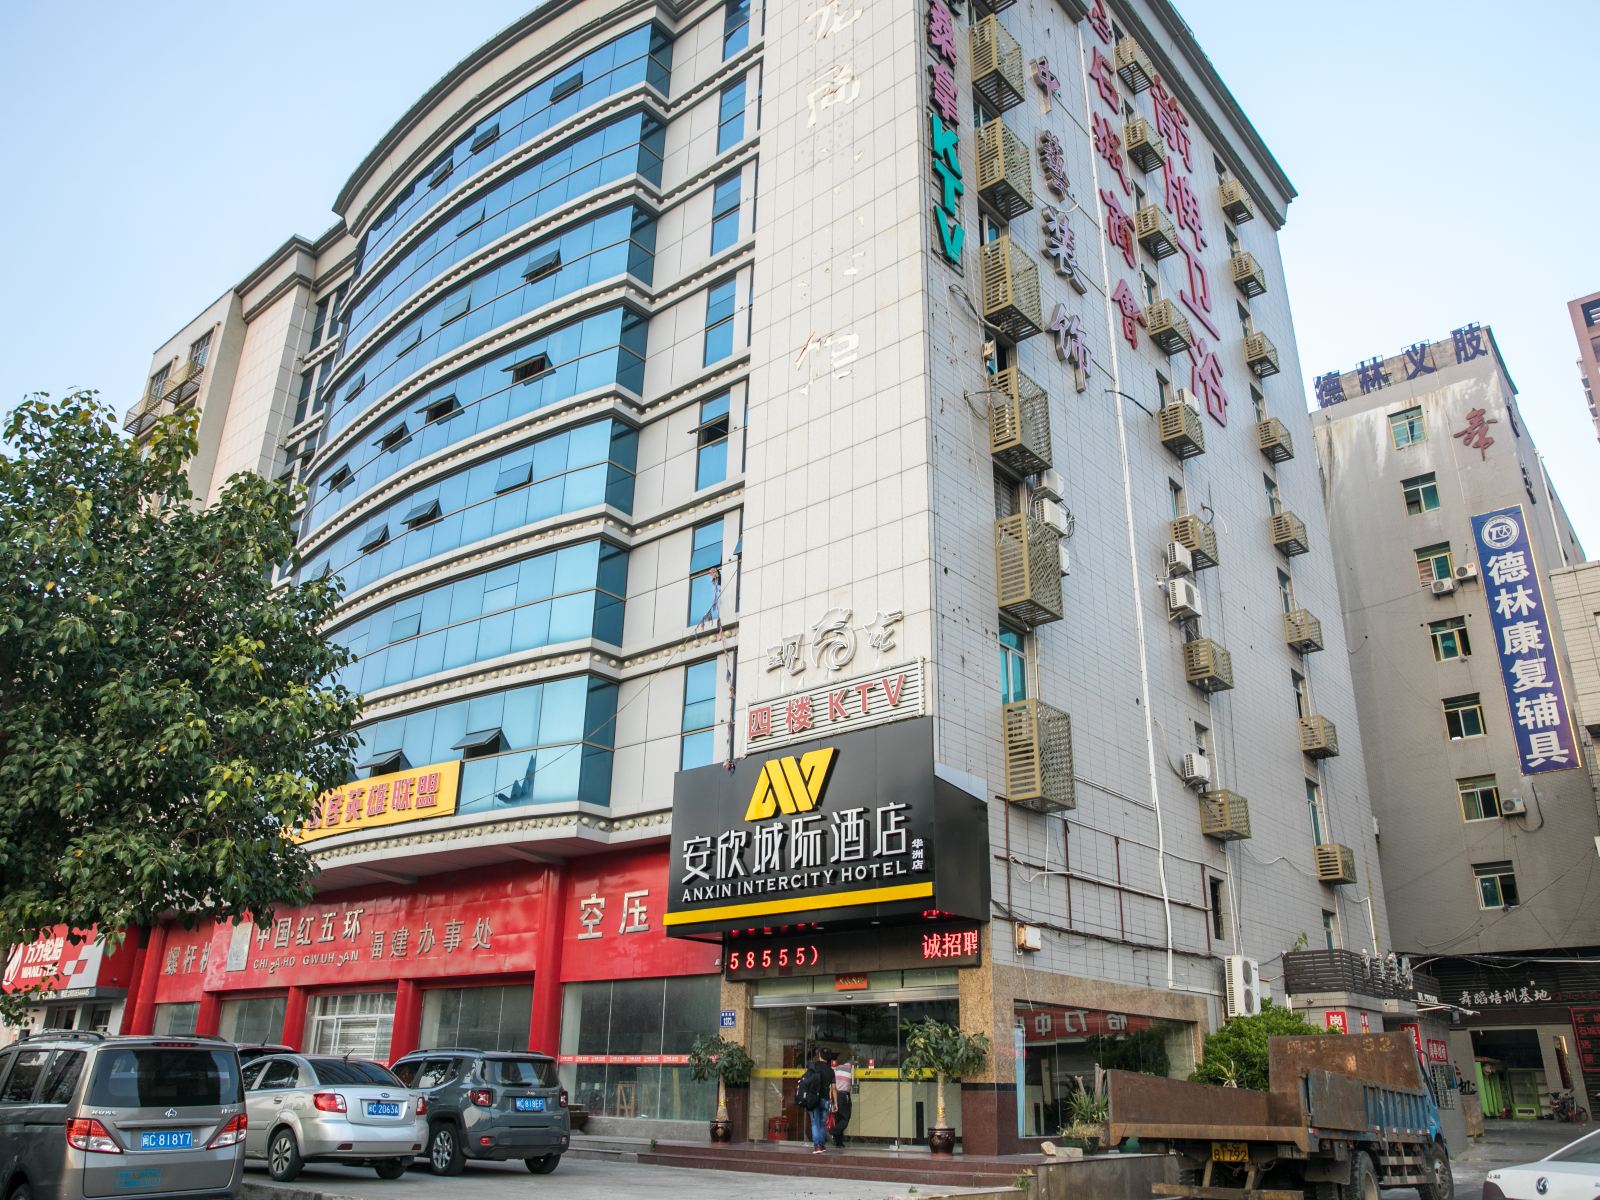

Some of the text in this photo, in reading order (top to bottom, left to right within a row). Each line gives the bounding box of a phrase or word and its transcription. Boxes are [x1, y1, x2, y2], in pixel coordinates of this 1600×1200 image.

[1314, 322, 1488, 408] 德林义肢
[1487, 550, 1569, 768] 德林康复辅具
[682, 802, 908, 884] 安欣城际酒店
[682, 860, 907, 902] ANXIN INTERCITY HOTEL
[578, 889, 649, 940] 空压
[1459, 986, 1551, 1007] 舞蹈培训基地
